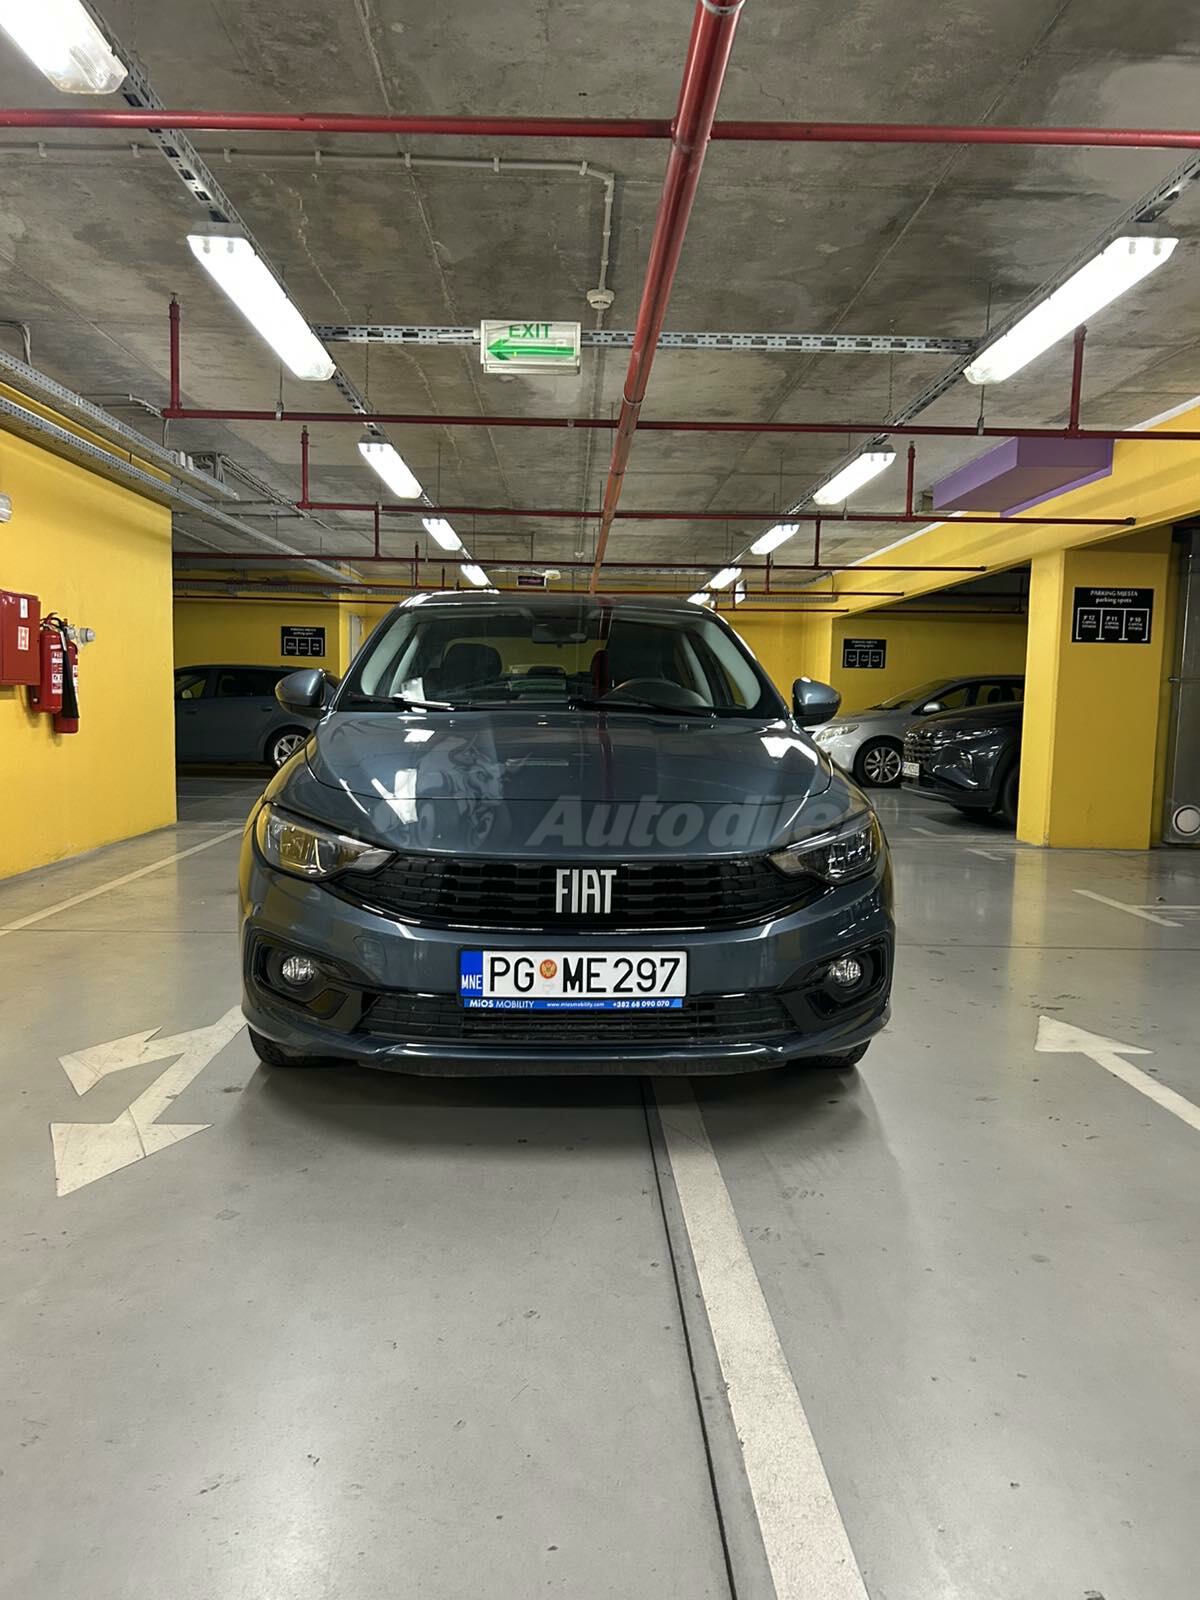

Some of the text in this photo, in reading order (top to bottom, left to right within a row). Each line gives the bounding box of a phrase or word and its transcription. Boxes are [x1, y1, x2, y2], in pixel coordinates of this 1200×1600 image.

[508, 323, 553, 339] EXIT
[555, 868, 618, 914] FIAT
[461, 974, 482, 990] MNE
[489, 956, 681, 993] PG ME297
[495, 1000, 535, 1009] MOBILITY
[612, 1000, 630, 1008] +382
[630, 1000, 641, 1008] 68
[641, 1000, 656, 1008] 090
[656, 1000, 670, 1008] 070
